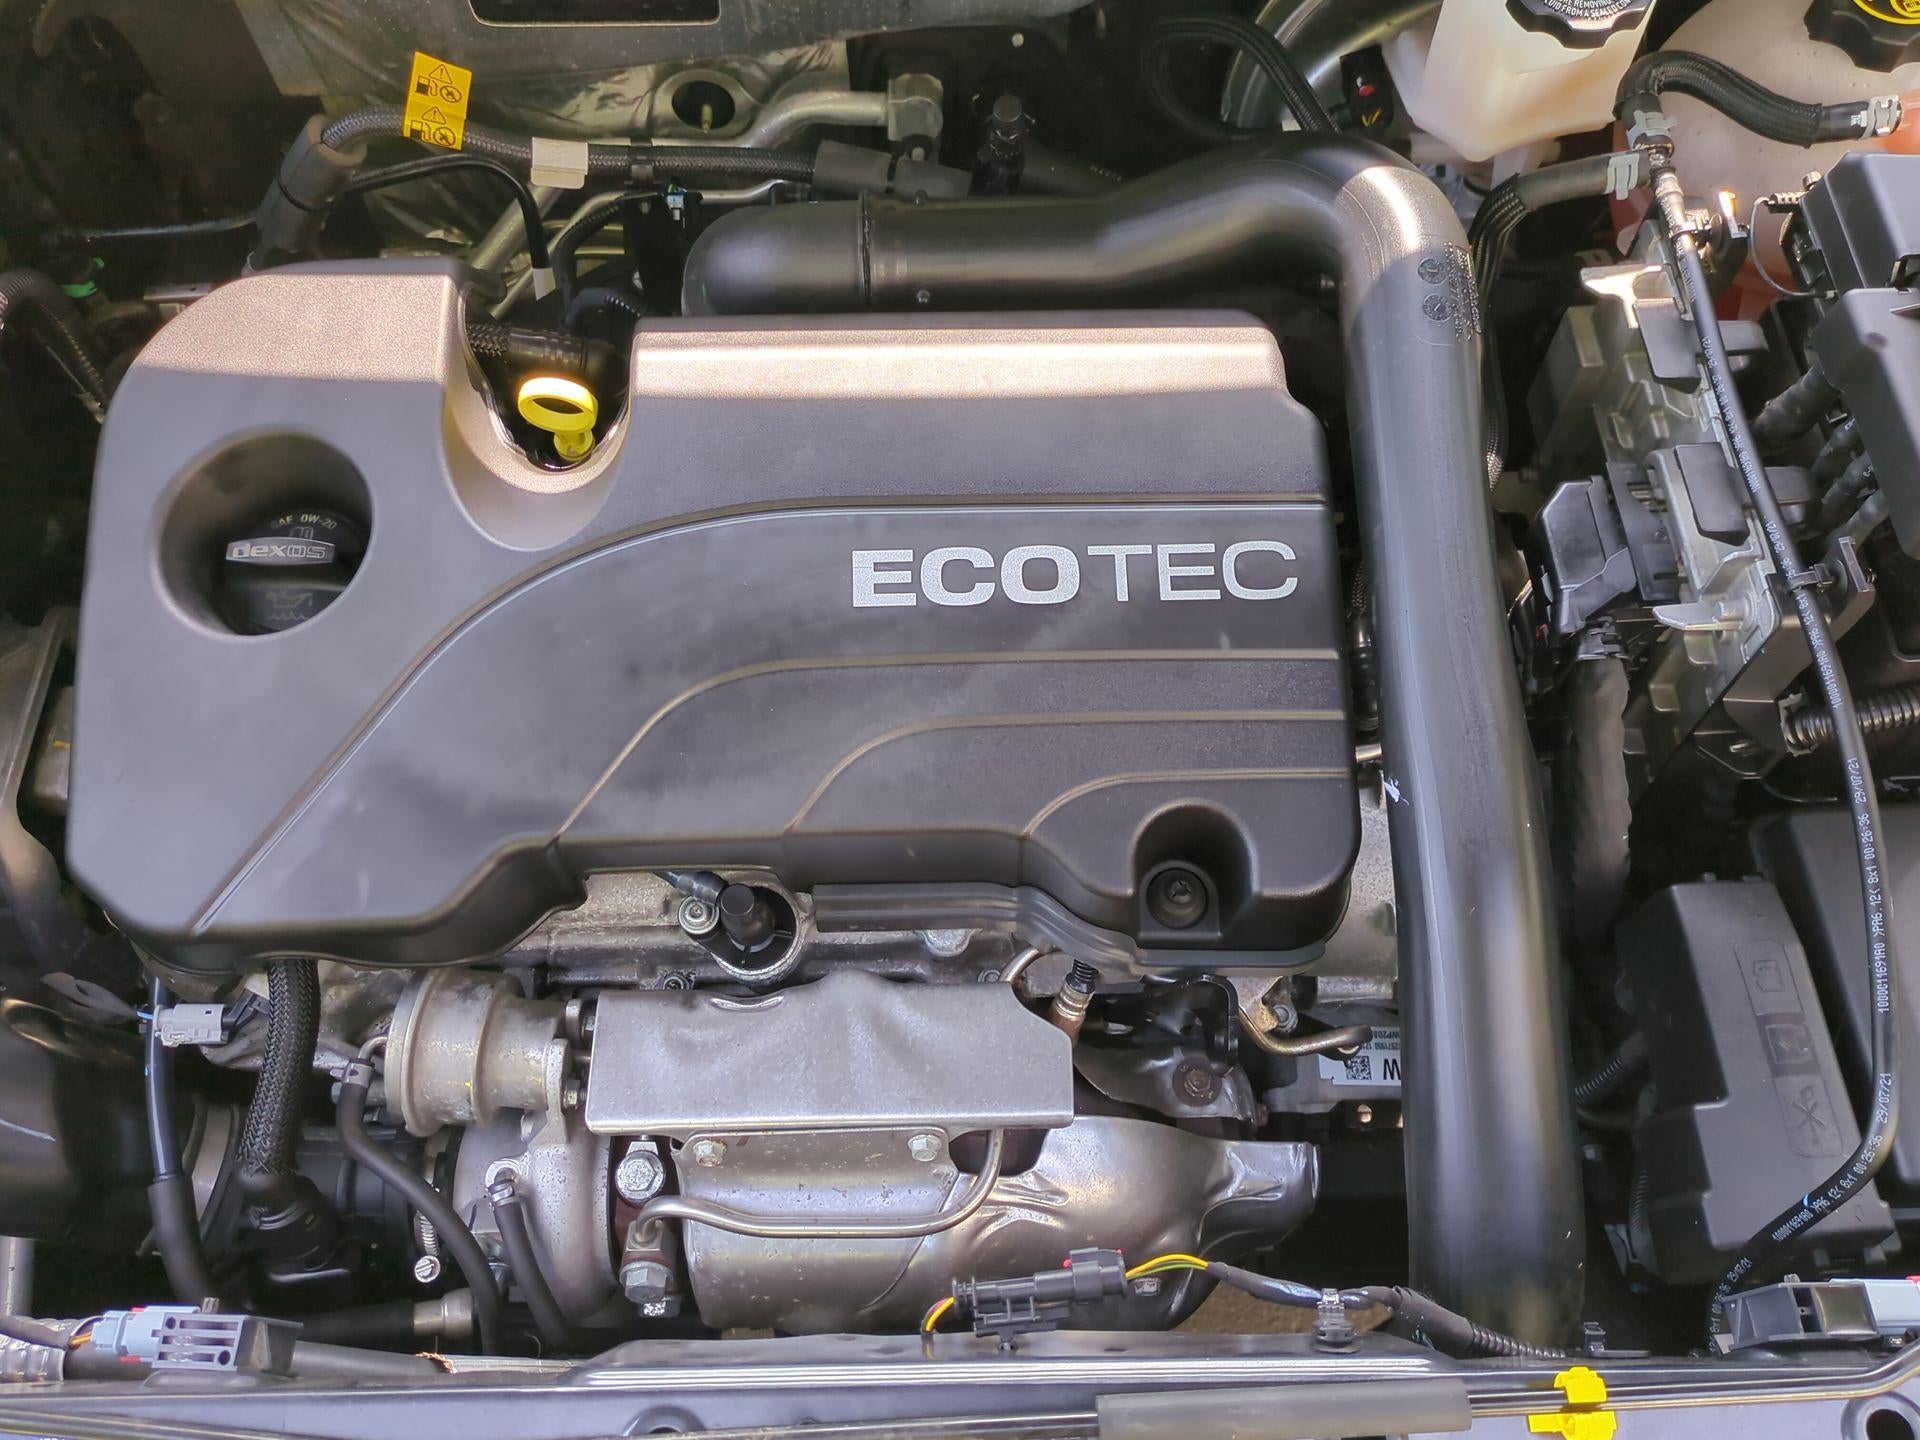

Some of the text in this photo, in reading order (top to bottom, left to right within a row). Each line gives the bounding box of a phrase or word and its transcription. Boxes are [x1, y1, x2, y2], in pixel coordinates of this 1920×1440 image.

[1561, 4, 1583, 17] FROM
[1590, 4, 1618, 18] SEALED
[301, 513, 337, 530] 0W-20
[232, 543, 326, 559] dexos
[853, 541, 1298, 607] ECOTEC
[1847, 757, 1866, 804] 29/07/21
[1858, 813, 1875, 860] 00:26:36
[1868, 865, 1879, 885] 8x1
[1839, 1173, 1858, 1189] 8x1
[1853, 1135, 1883, 1175] 00:26:36
[1876, 1073, 1891, 1124] 29/07/21
